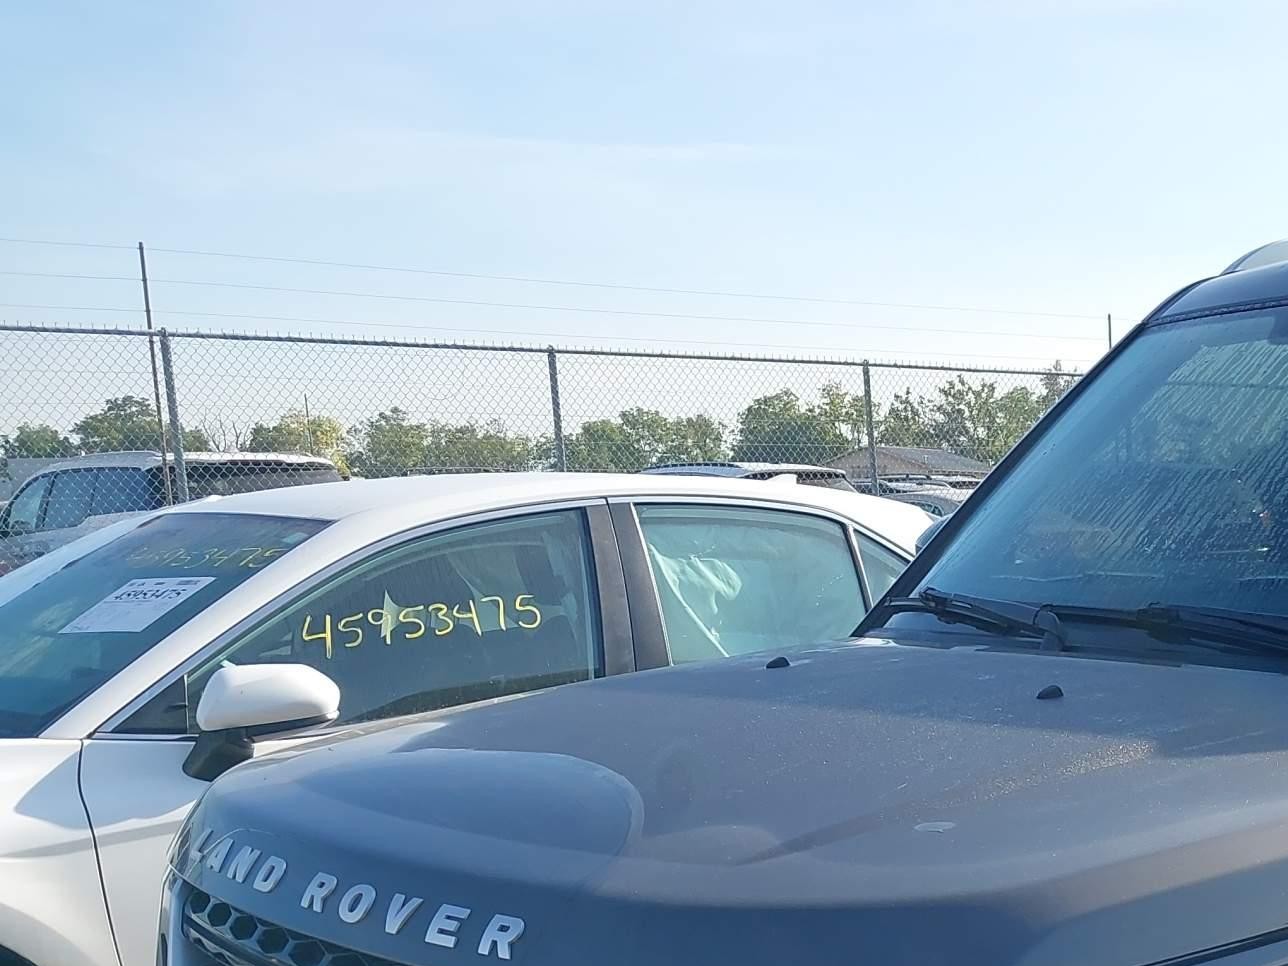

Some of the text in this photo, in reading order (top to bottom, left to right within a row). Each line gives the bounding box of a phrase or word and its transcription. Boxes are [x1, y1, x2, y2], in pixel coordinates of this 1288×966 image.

[302, 594, 542, 659] 45953475
[189, 828, 525, 960] LAND ROVER
